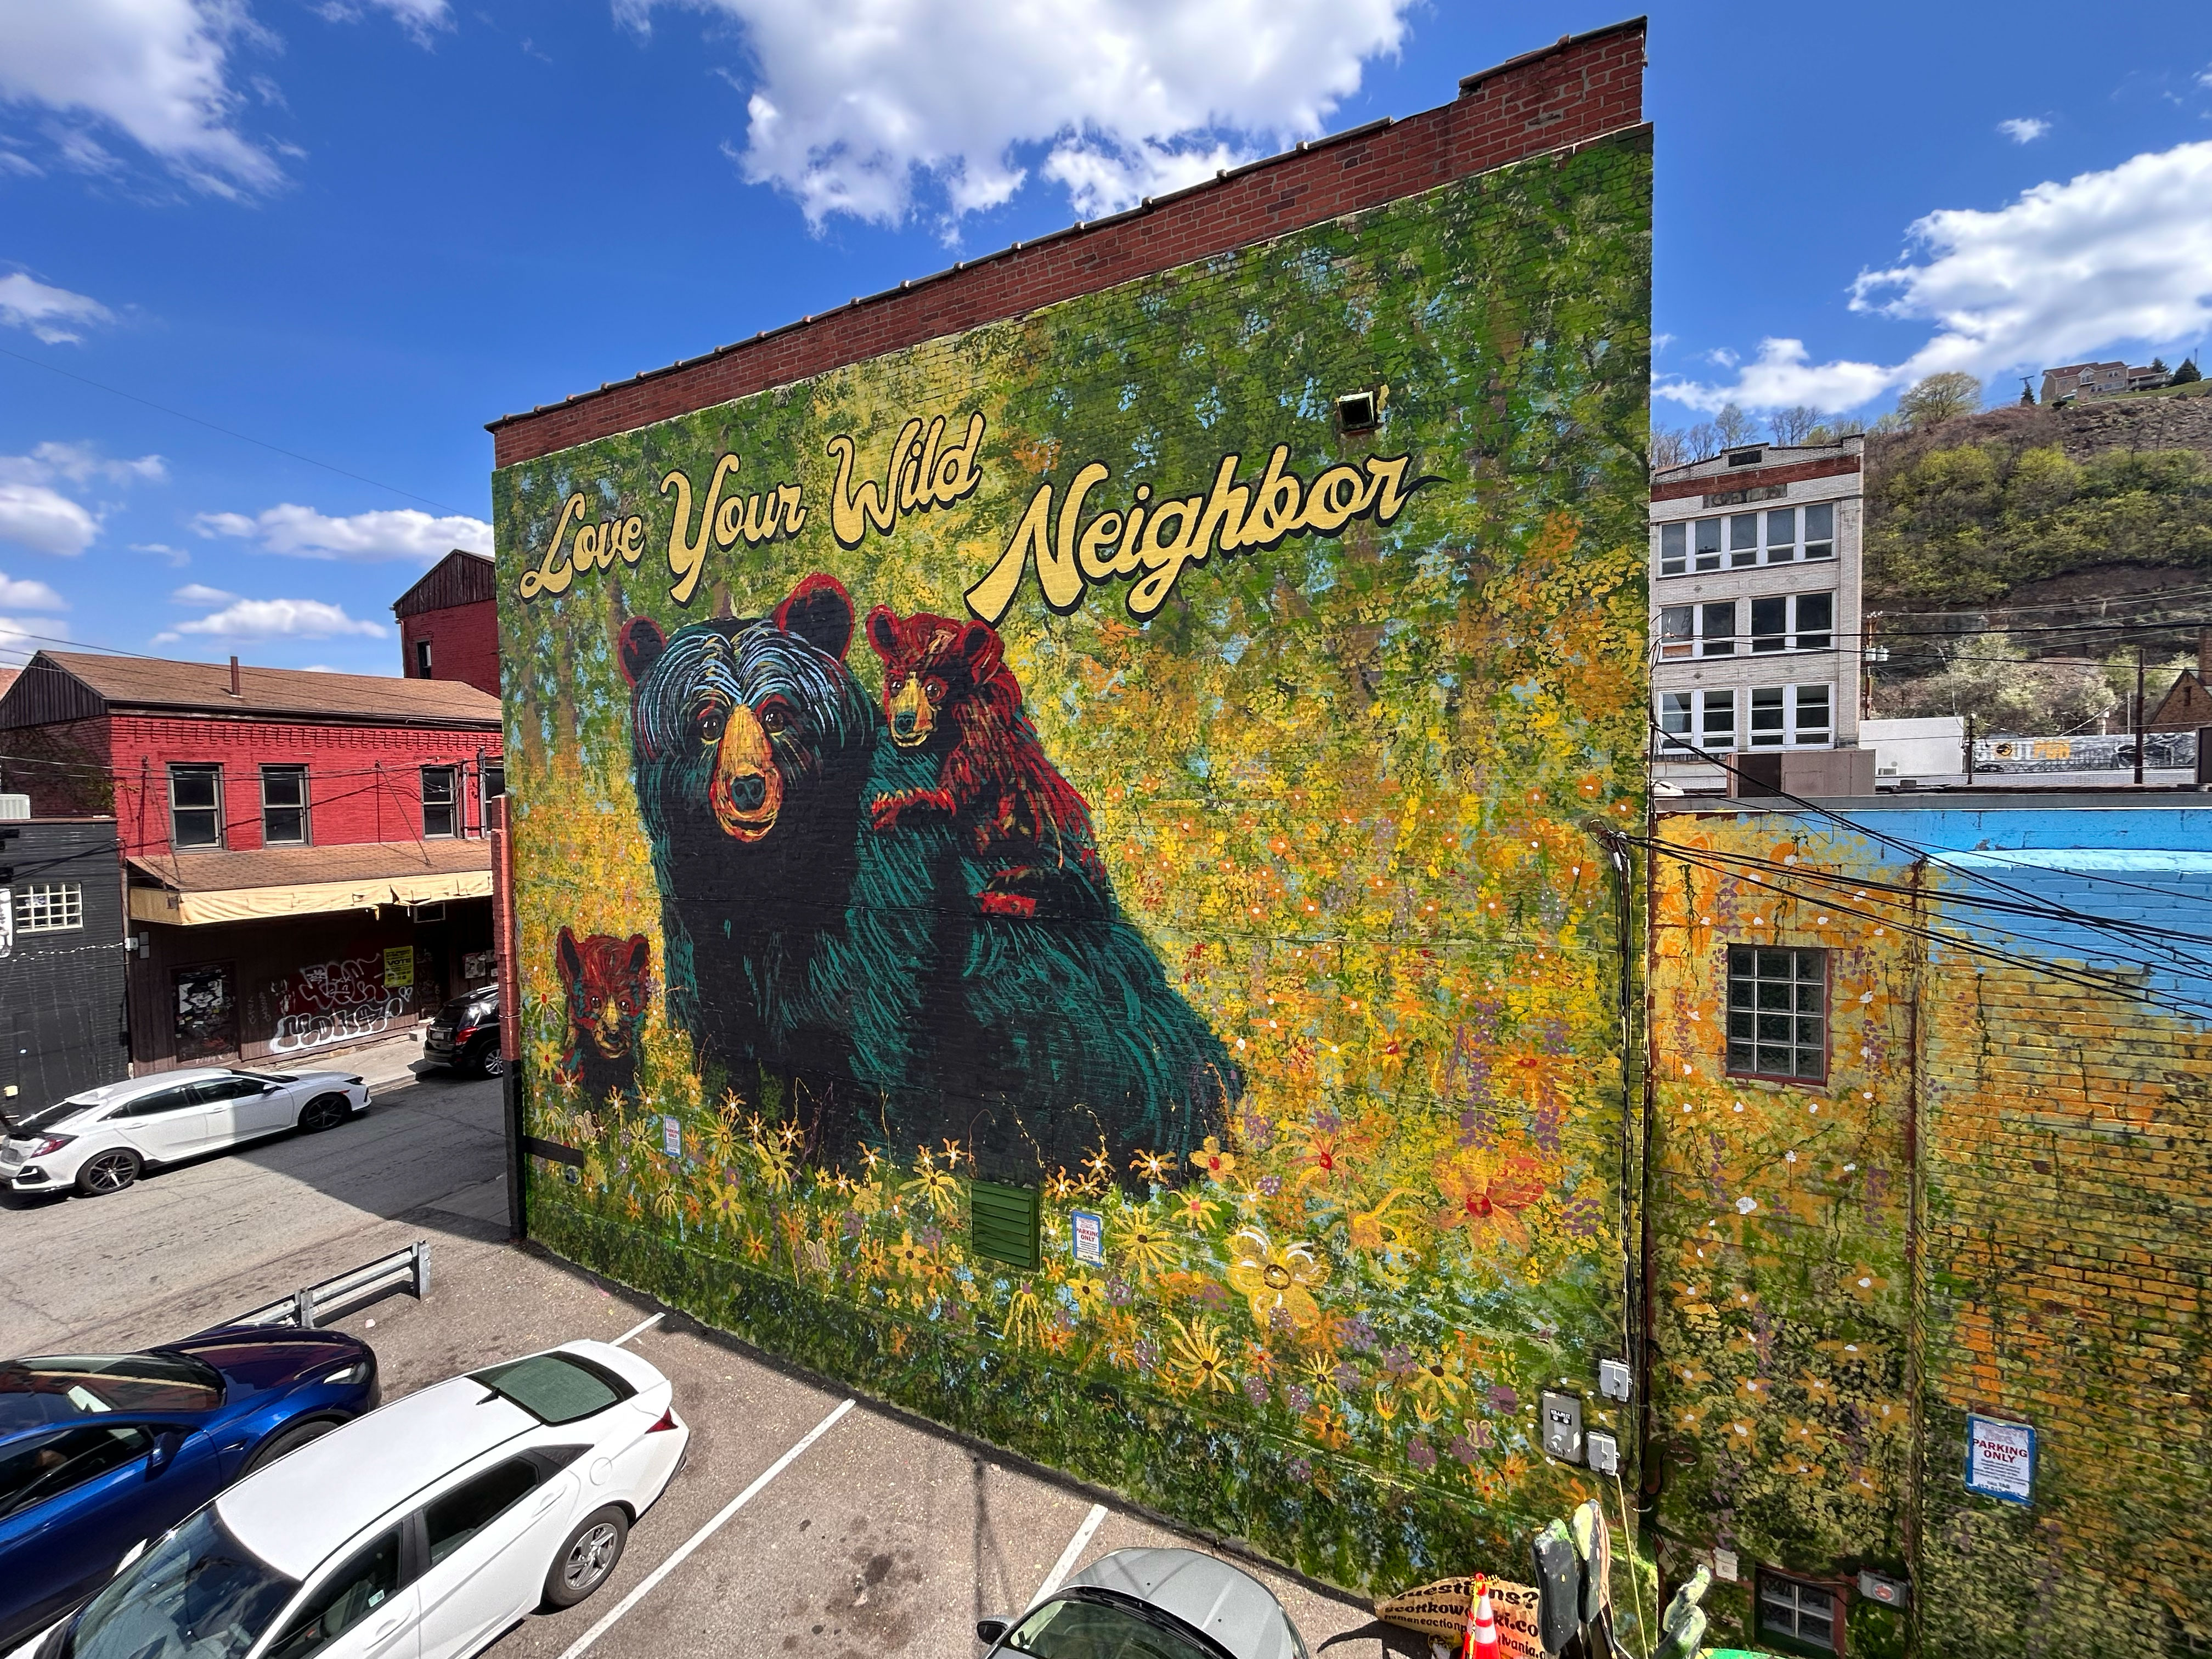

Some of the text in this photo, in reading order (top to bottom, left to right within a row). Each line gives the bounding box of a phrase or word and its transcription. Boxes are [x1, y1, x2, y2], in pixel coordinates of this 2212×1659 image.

[520, 410, 1448, 629] Love Your Wild Neighbor
[1973, 1438, 2028, 1458] PARKING
[1984, 1449, 2015, 1463] ONLY
